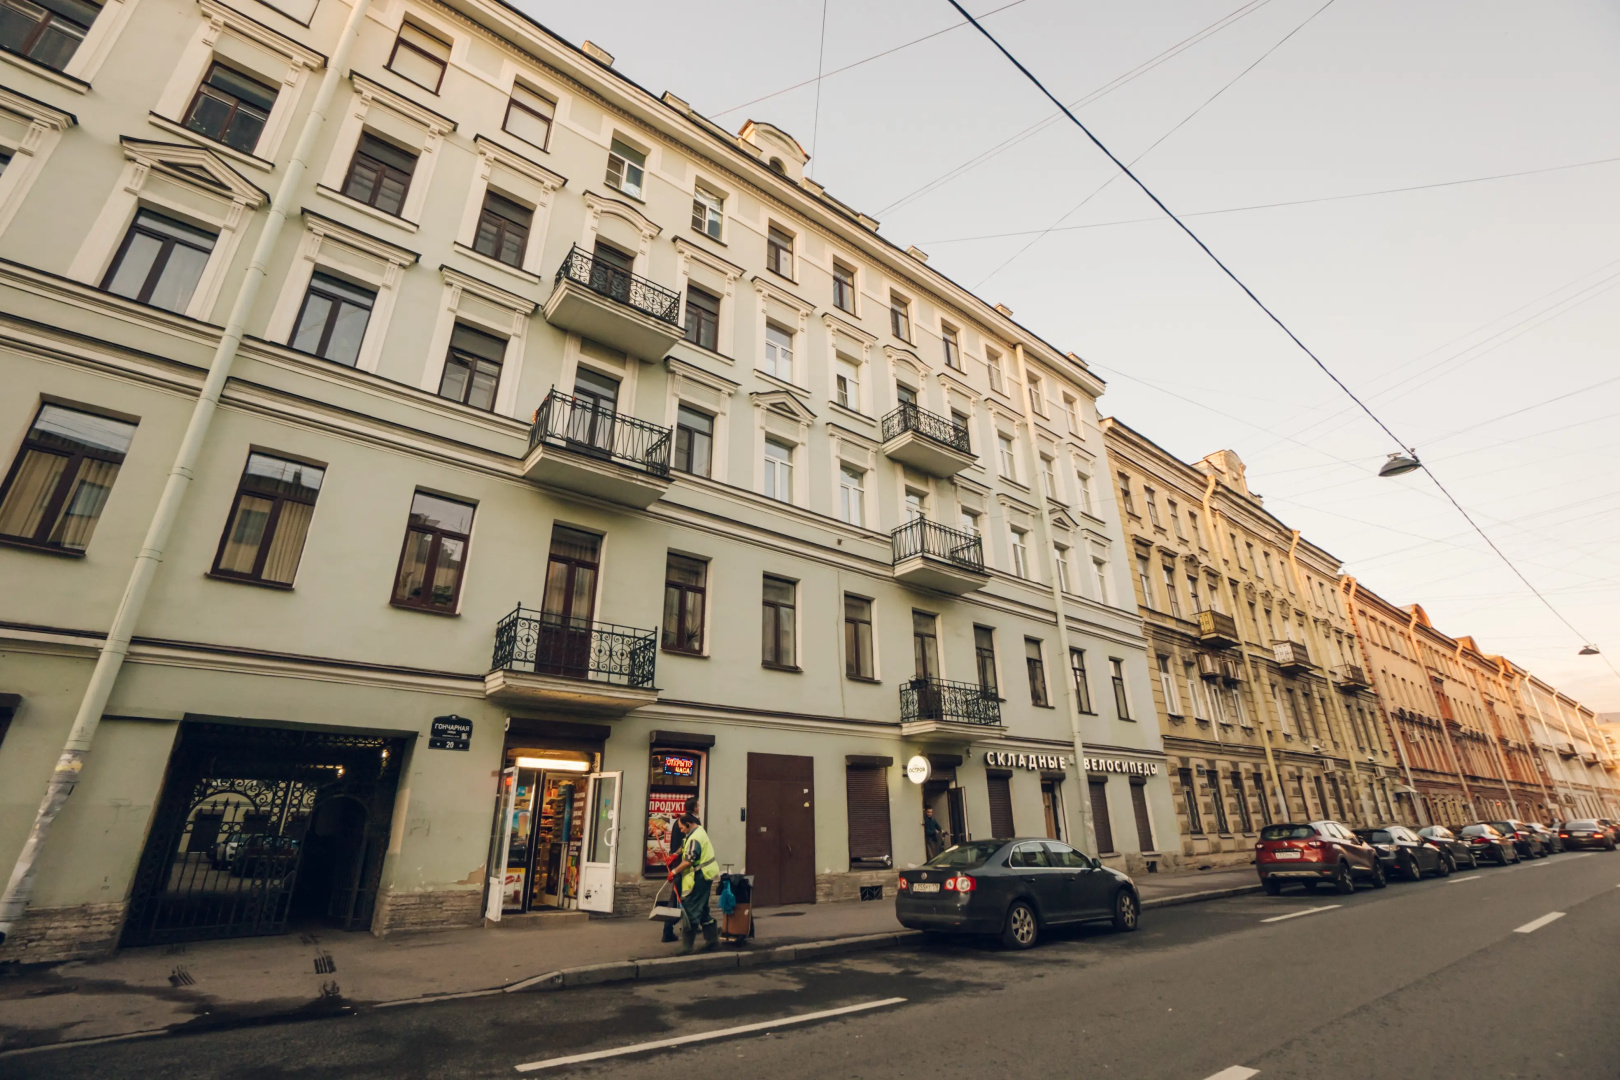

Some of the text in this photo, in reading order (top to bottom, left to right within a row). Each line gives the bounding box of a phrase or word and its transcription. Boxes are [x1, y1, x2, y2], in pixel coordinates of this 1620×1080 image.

[434, 722, 470, 732] ГОНЧАРНАЯ
[445, 741, 455, 749] 20
[985, 751, 1158, 776] СКЛАДНЫЕ ВЕЛОСИПЕДЫ
[648, 800, 686, 813] ПРОДУКТ
